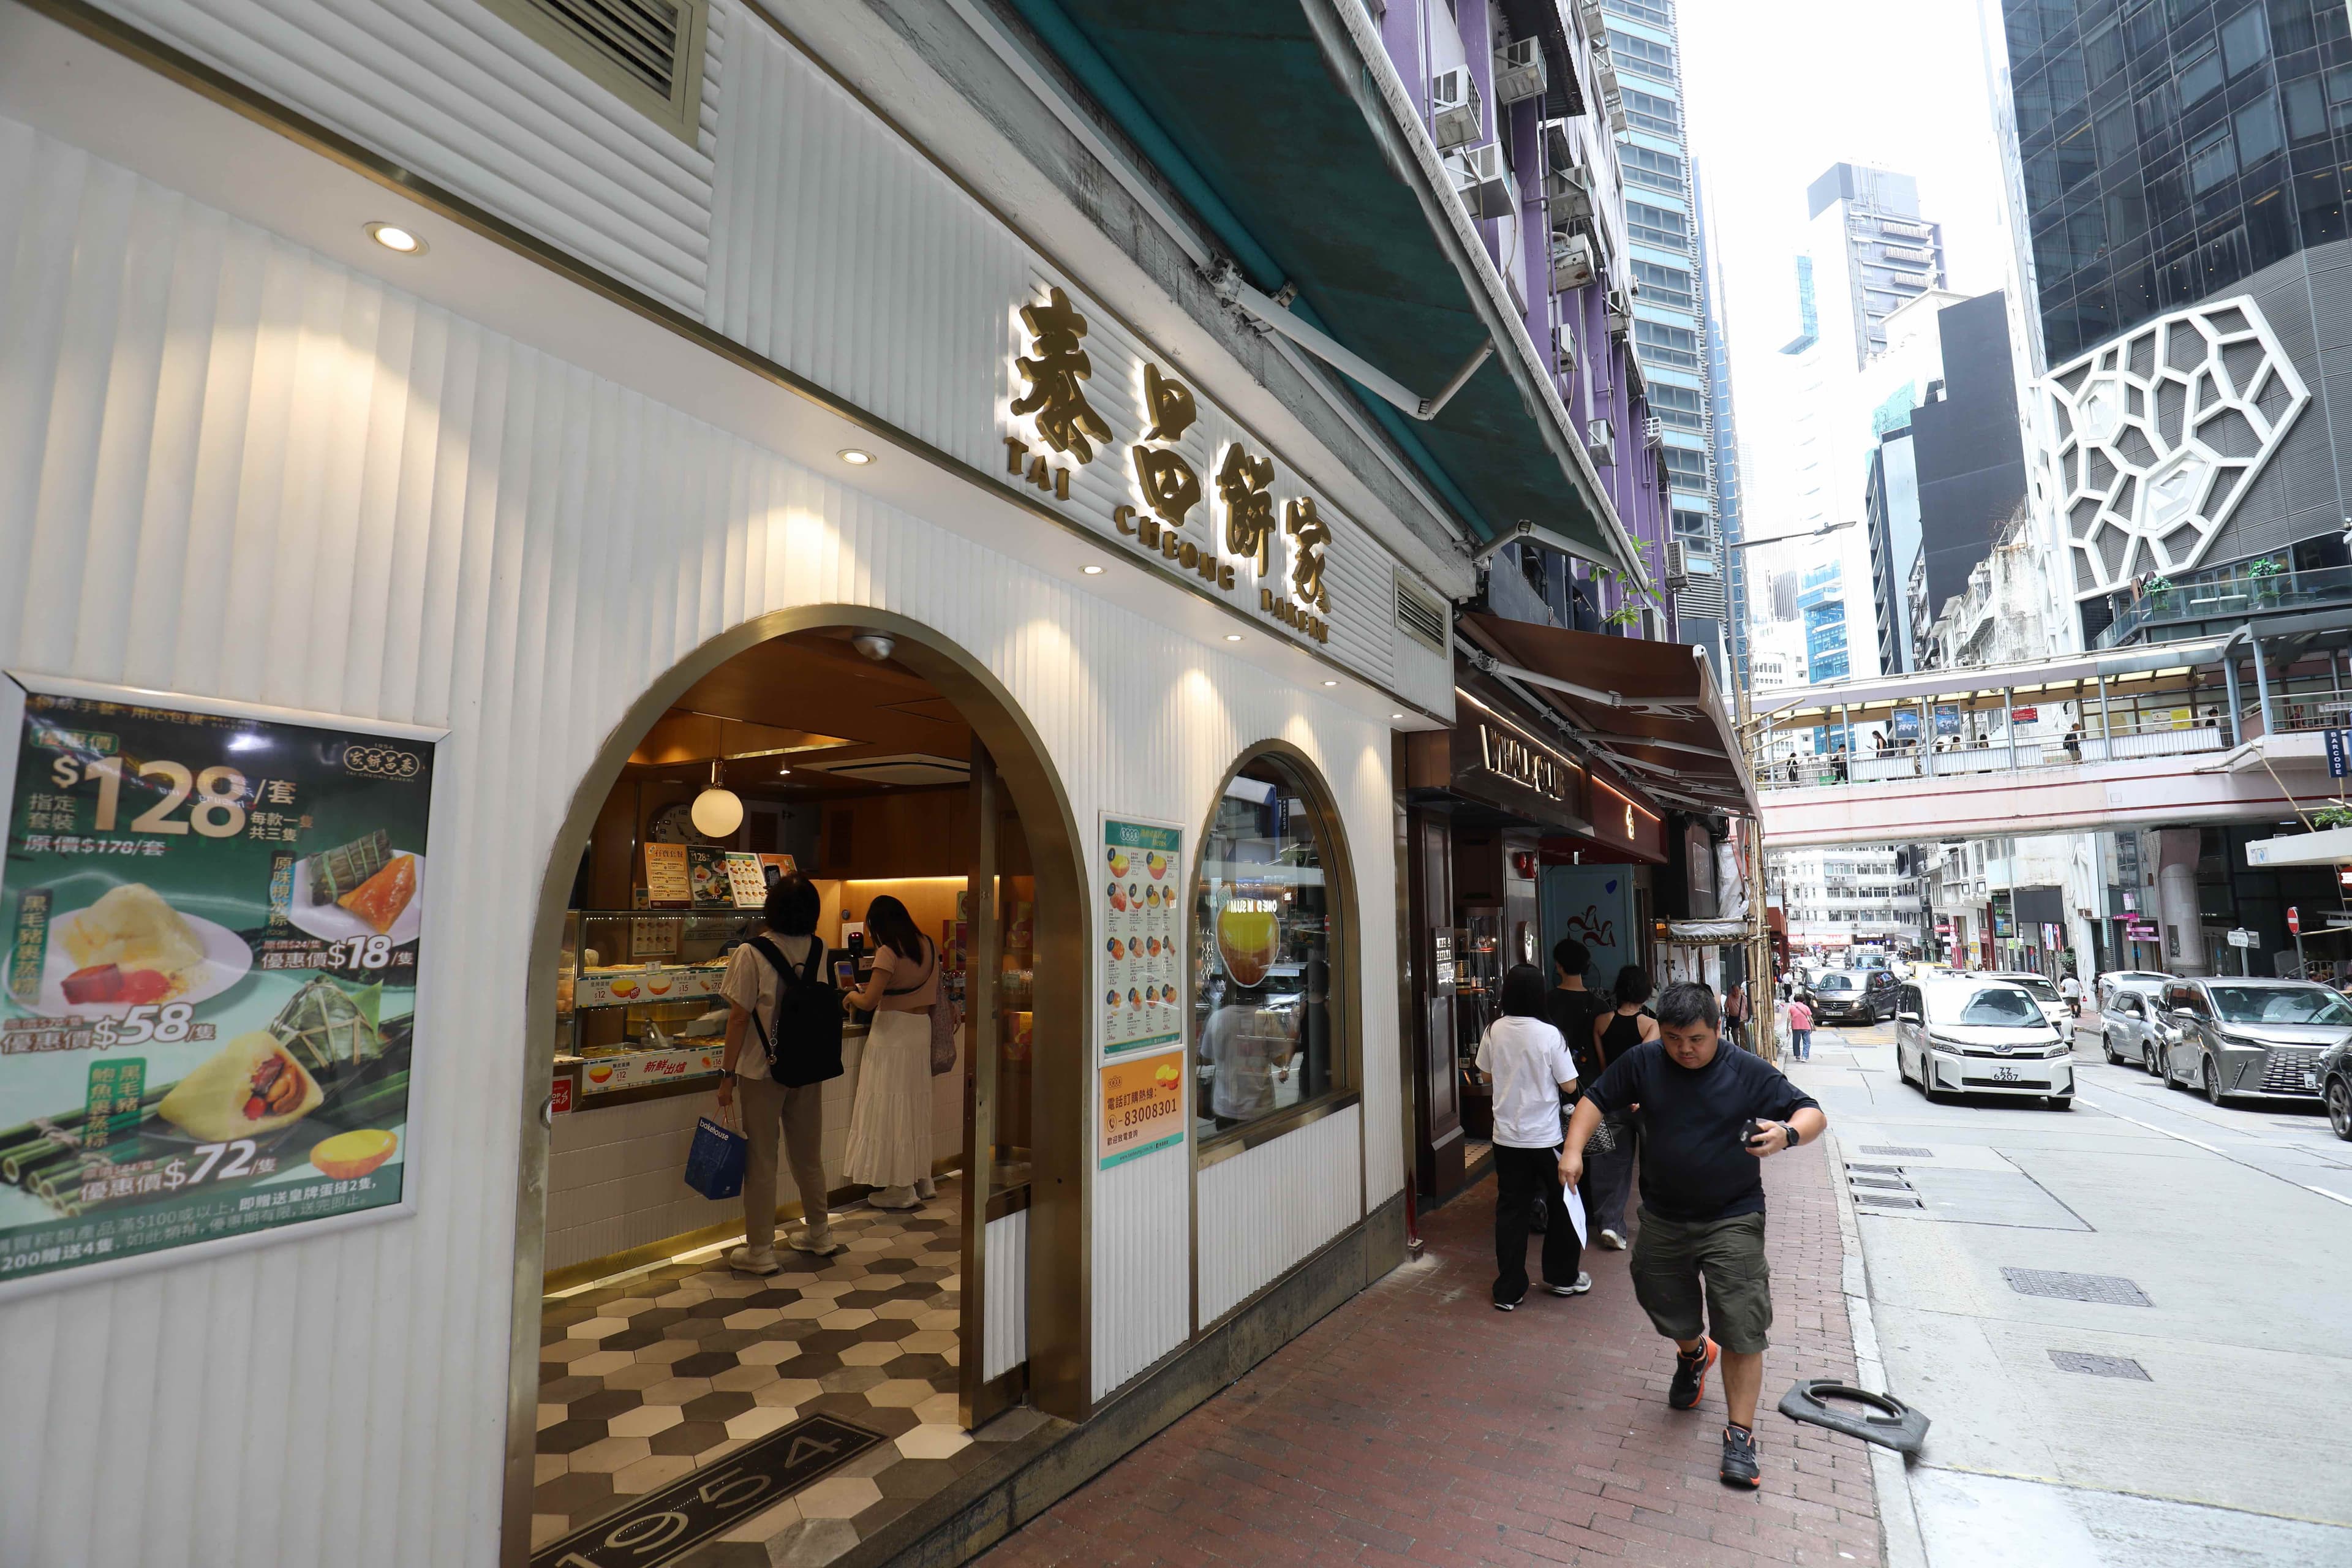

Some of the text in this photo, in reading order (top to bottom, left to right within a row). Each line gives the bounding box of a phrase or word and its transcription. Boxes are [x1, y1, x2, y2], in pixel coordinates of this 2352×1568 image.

[1010, 286, 1332, 614] 泰昌餅家
[1004, 437, 1071, 500] TAI
[1114, 505, 1235, 590] CHEONG
[2330, 731, 2342, 775] BARCODE
[250, 812, 314, 829] 每款一隻
[249, 826, 298, 842] 共三隻
[631, 987, 640, 996] HOT
[643, 1058, 687, 1076] 新鮮出爐
[699, 1119, 729, 1141] bakehouse
[1107, 1129, 1138, 1147] 歡迎致電查詢
